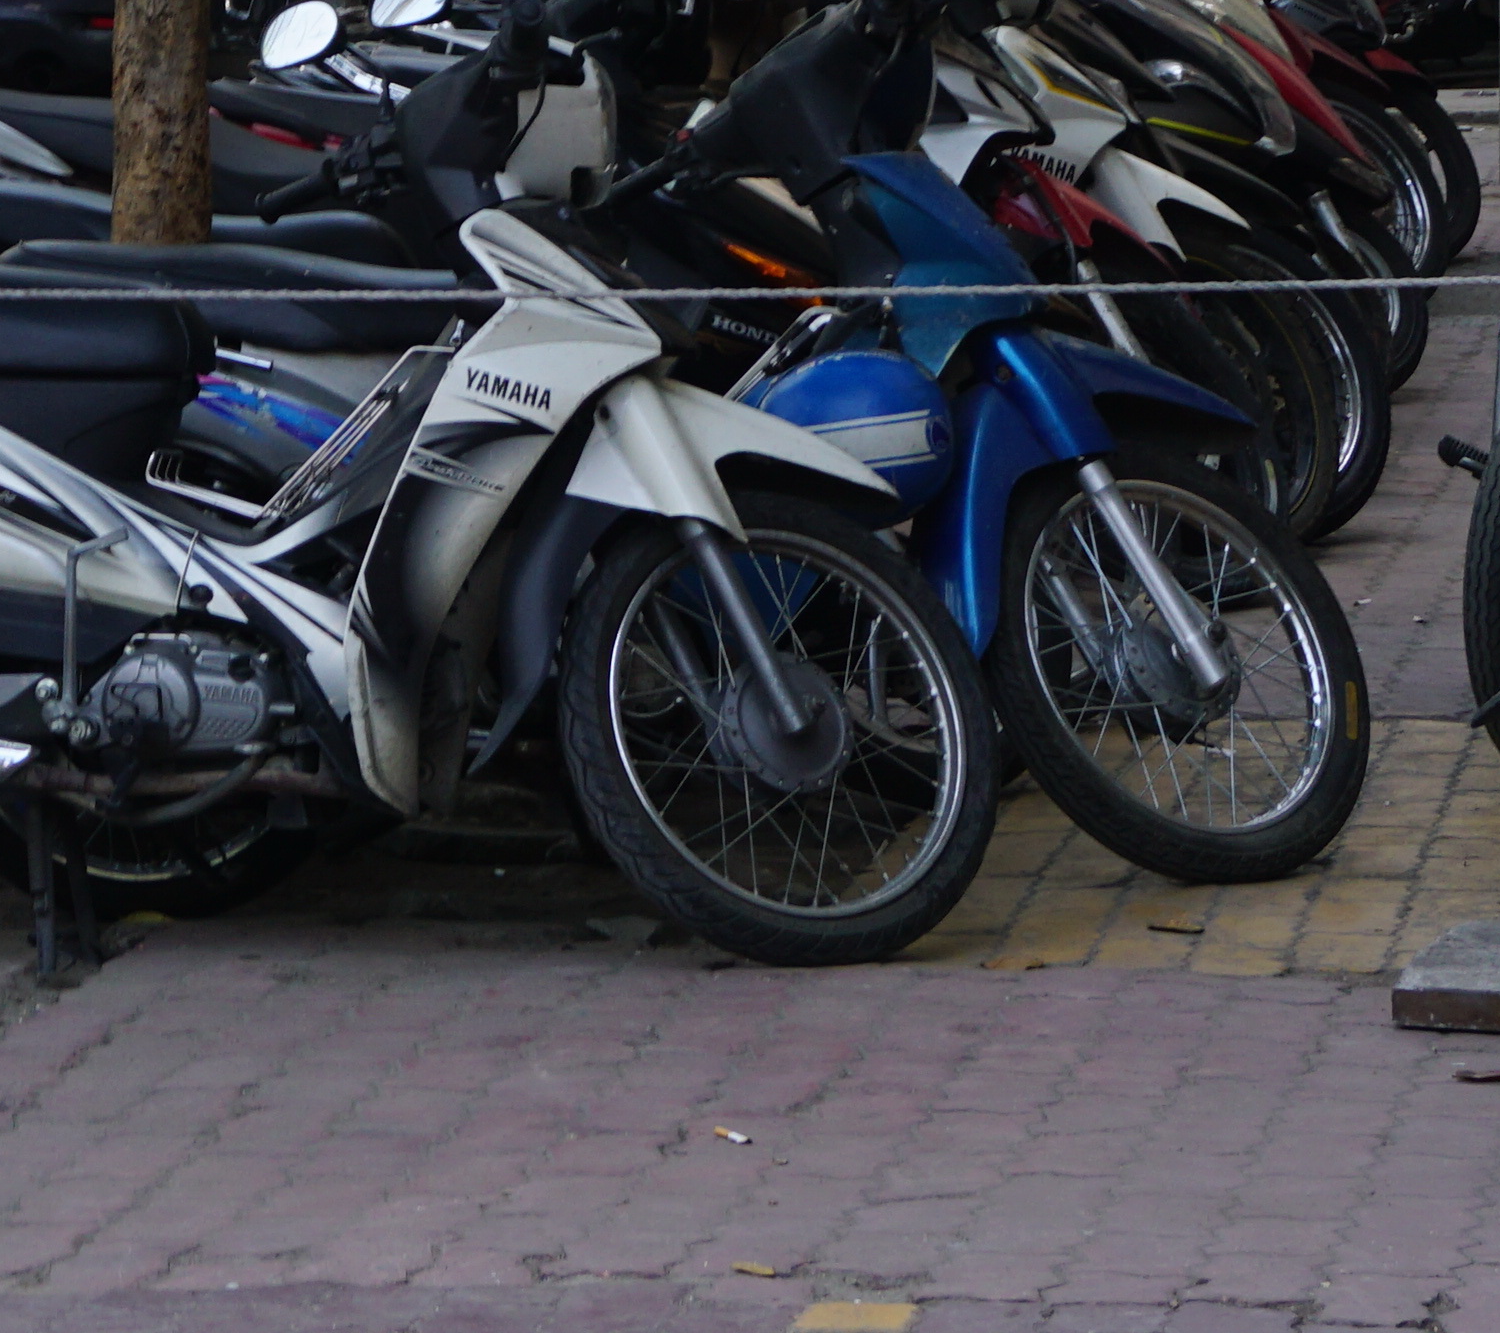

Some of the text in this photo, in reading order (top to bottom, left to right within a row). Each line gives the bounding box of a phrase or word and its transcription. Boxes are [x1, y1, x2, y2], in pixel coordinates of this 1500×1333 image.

[711, 314, 780, 345] HOND
[465, 365, 552, 412] YAMAHA
[204, 684, 259, 704] YAMAHA
